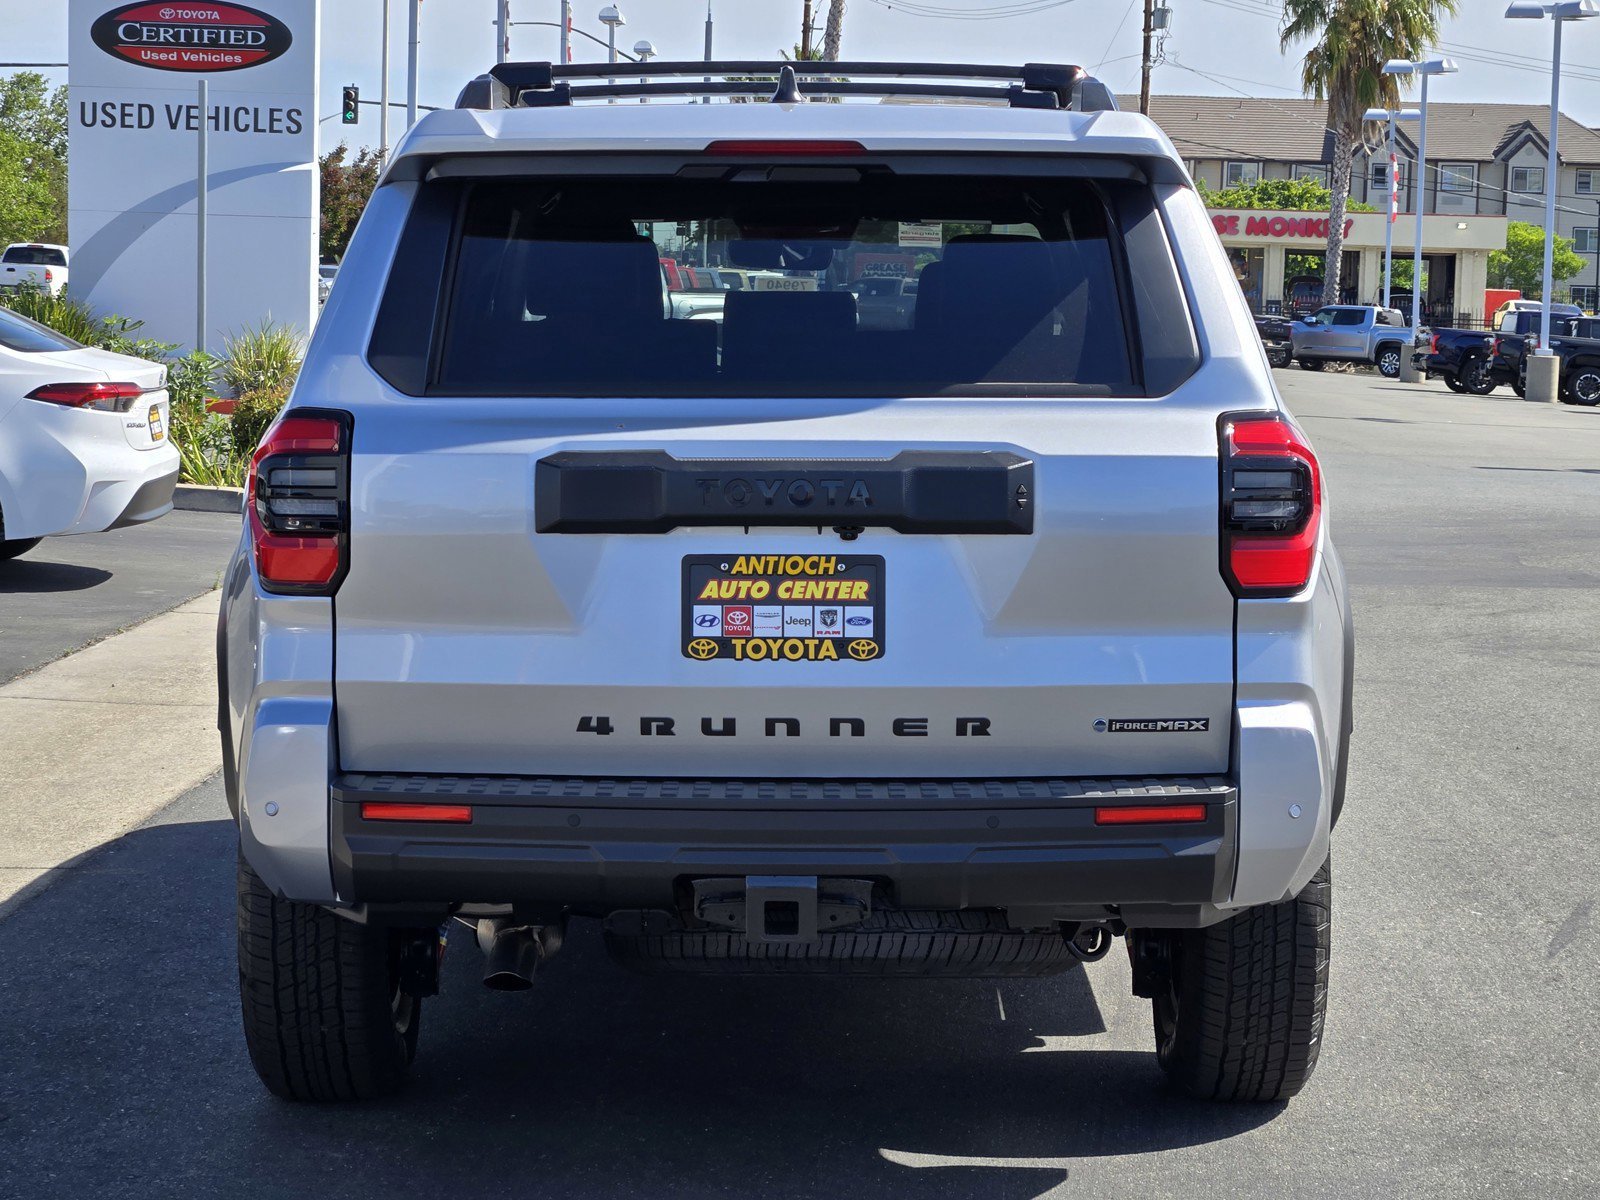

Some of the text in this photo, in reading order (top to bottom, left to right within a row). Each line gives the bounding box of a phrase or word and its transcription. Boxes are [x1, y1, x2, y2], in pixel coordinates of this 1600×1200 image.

[177, 10, 220, 20] TOYOTA
[117, 22, 266, 46] CERTIFIED
[141, 50, 242, 63] Used Vehicles
[79, 101, 303, 135] USED VEHICLES
[695, 477, 874, 509] TOYOTA
[730, 555, 837, 575] ANTIOCH
[699, 579, 870, 600] AUTO CENTER
[785, 615, 812, 627] Jeep
[731, 638, 839, 660] TOYOTA
